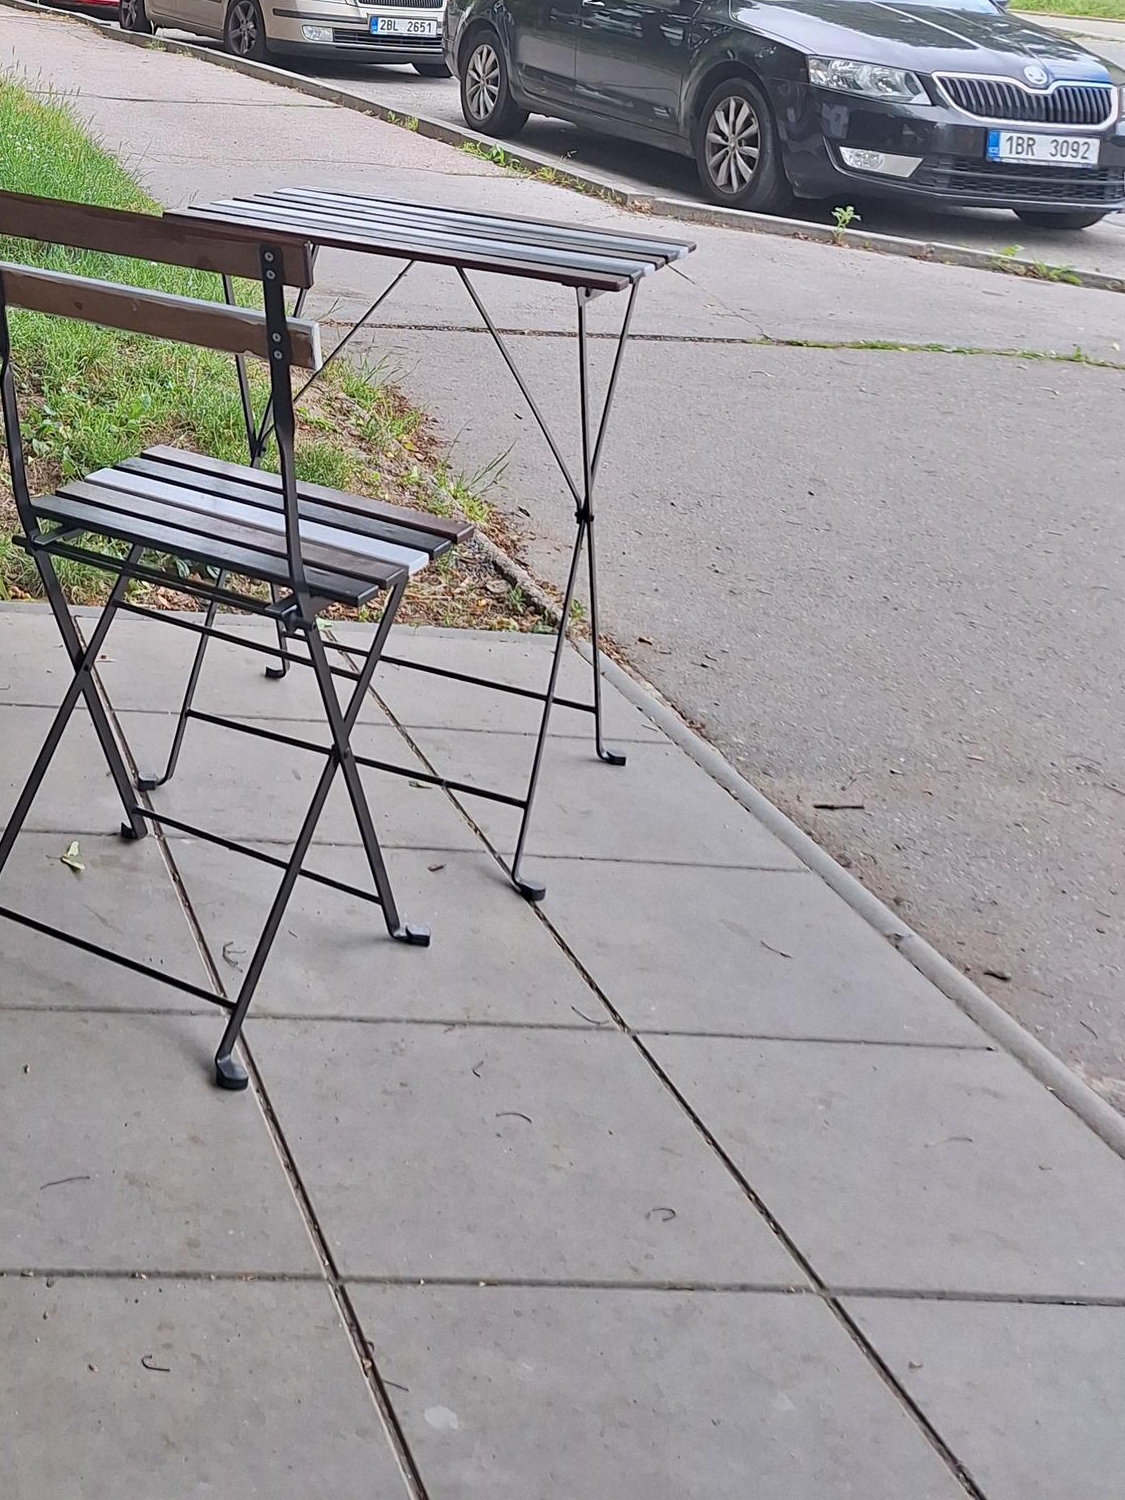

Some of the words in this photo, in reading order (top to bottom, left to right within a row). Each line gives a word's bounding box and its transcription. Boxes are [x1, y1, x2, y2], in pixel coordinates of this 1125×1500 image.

[380, 19, 399, 32] 2BL
[406, 20, 432, 33] 2651
[1005, 134, 1036, 157] 1BR
[1049, 138, 1091, 160] 3092
